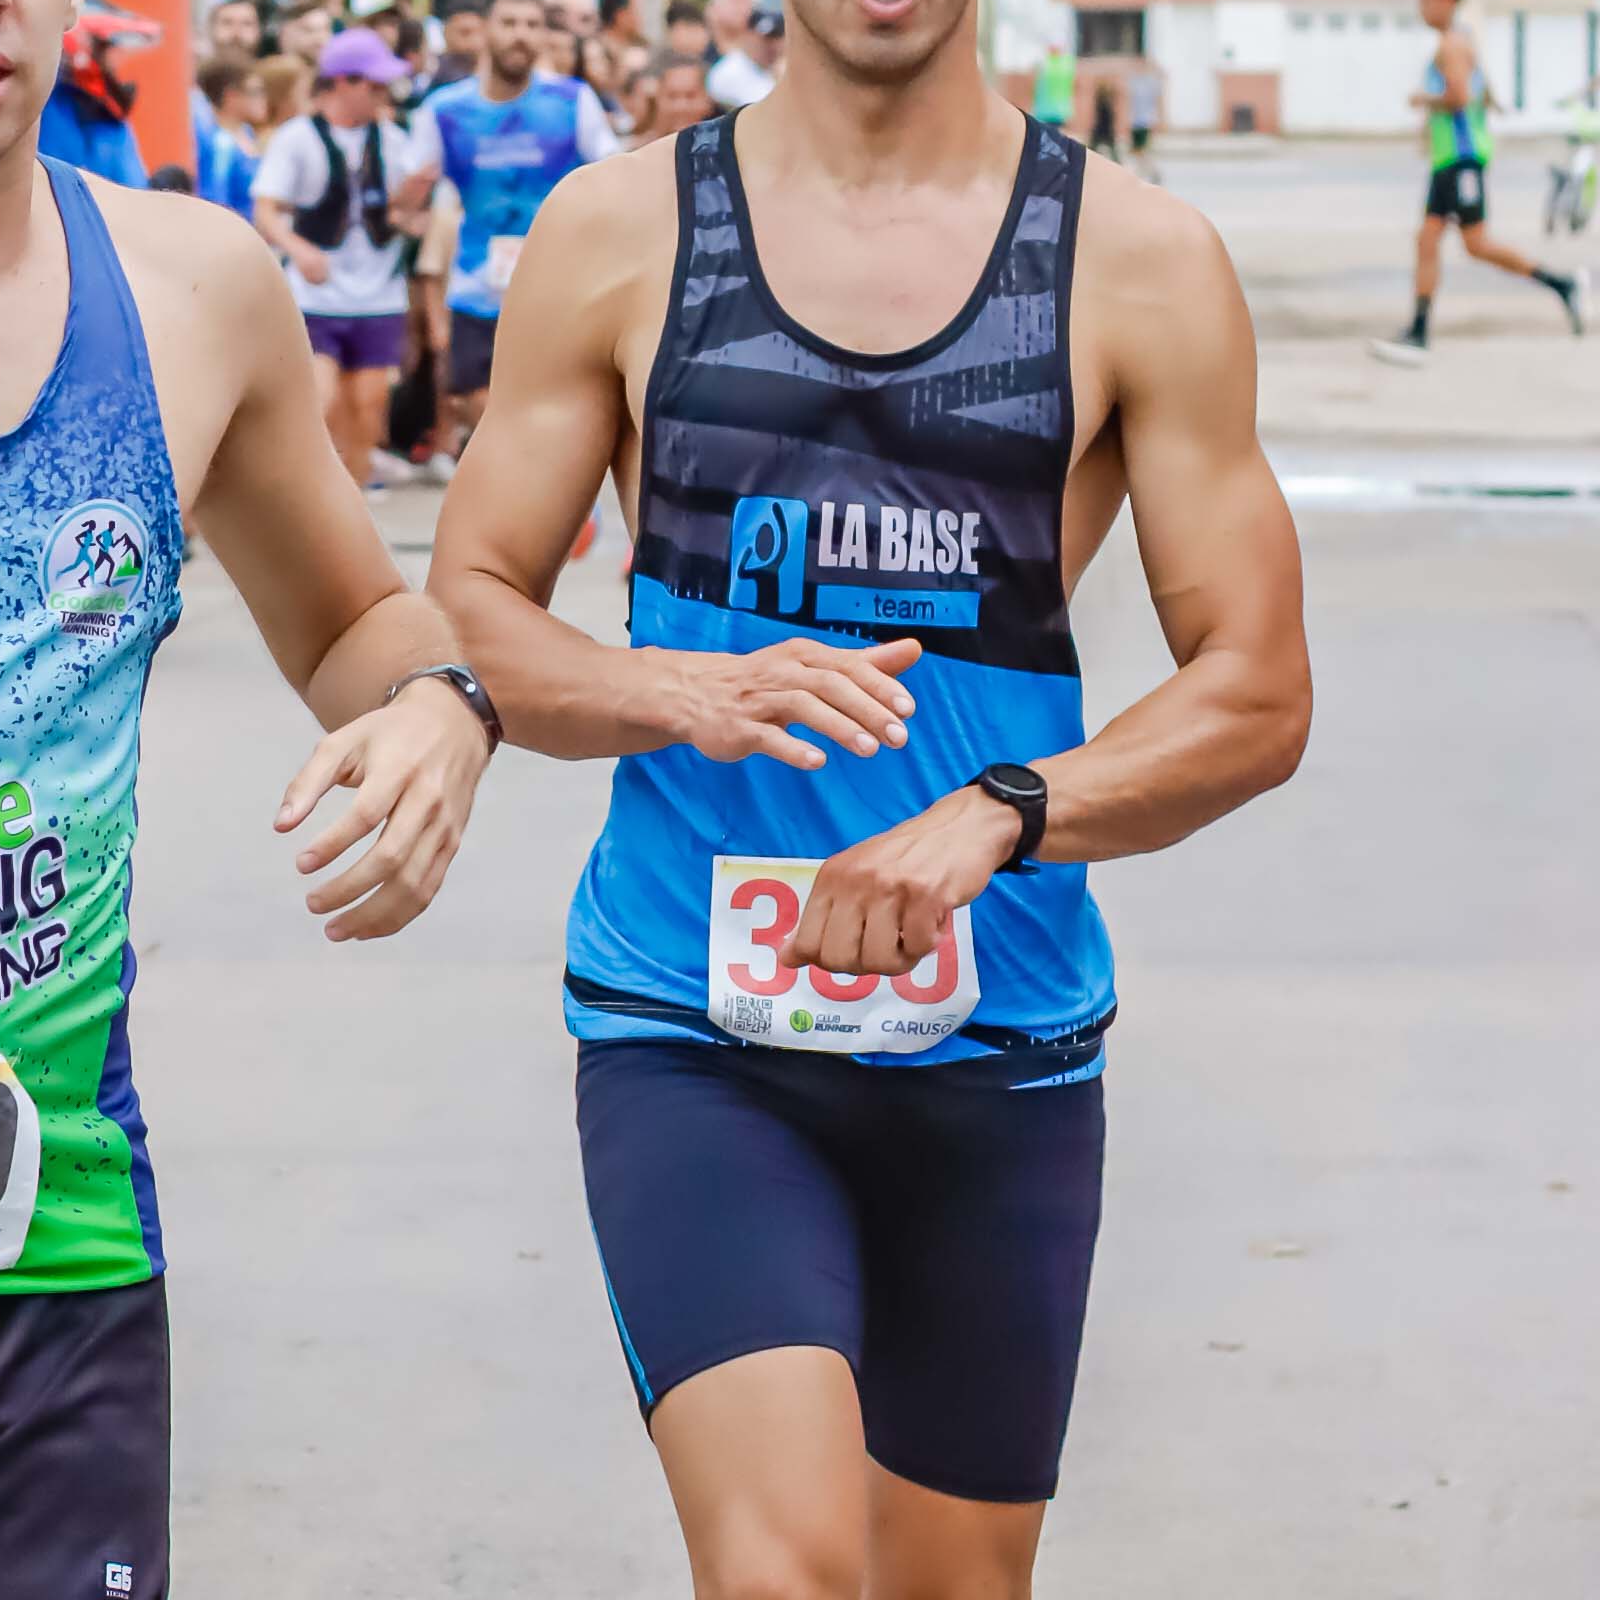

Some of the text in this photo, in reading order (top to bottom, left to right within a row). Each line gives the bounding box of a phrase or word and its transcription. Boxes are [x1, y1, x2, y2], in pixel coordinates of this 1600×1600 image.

[818, 501, 980, 575] LA BASE
[873, 594, 934, 620] team
[816, 1014, 841, 1023] CLUB
[881, 1019, 953, 1036] CARUSO
